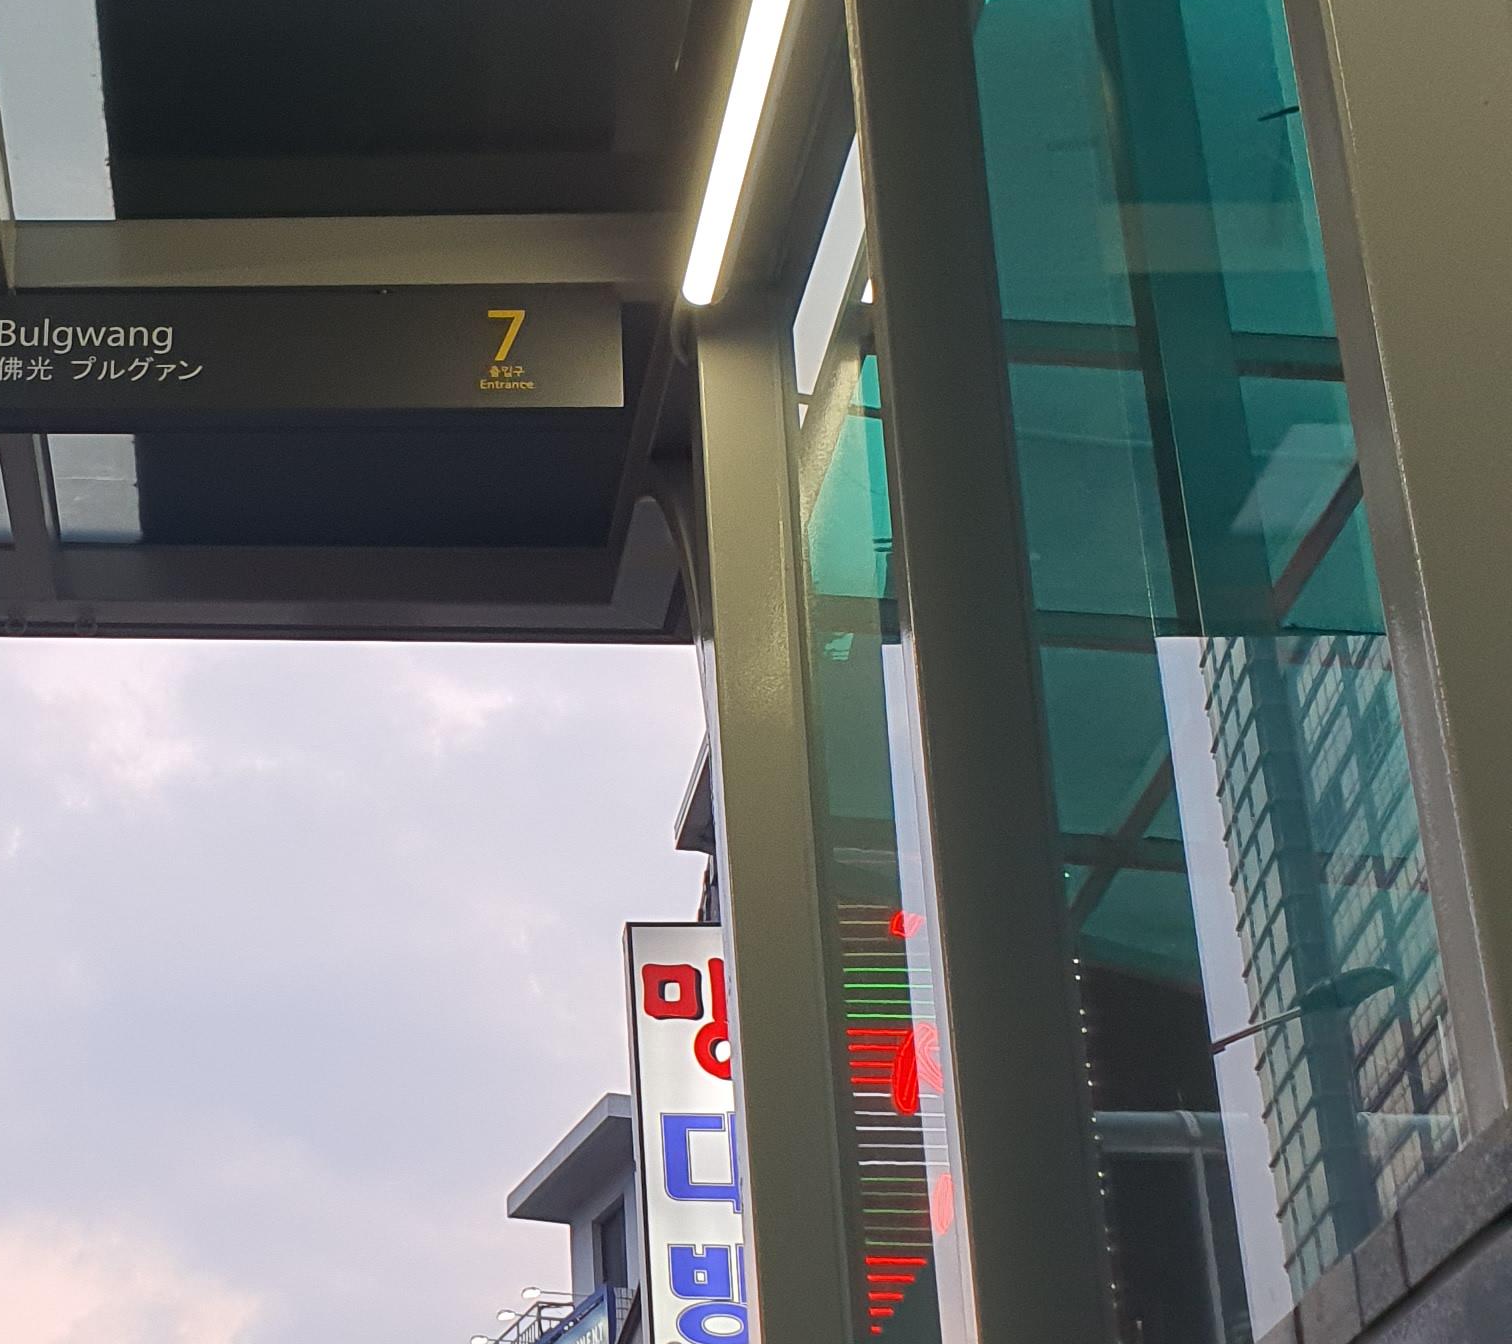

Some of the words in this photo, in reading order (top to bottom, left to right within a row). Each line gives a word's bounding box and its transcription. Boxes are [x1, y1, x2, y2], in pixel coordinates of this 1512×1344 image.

[488, 310, 526, 361] 7
[70, 356, 203, 381] プルグァン
[479, 379, 535, 389] Entrance
